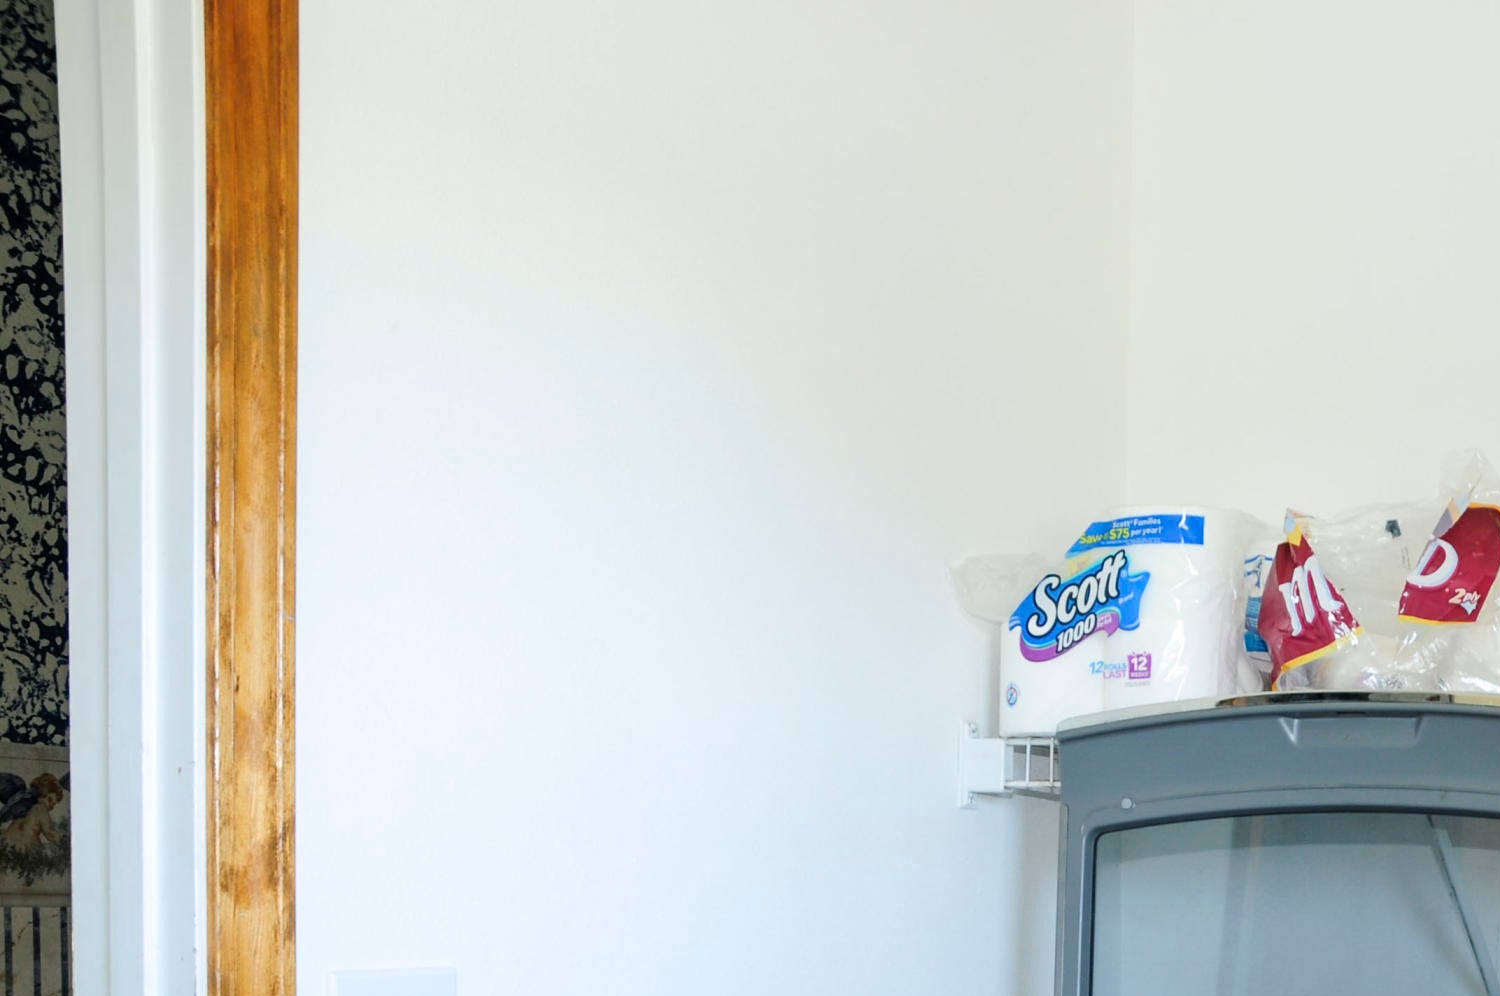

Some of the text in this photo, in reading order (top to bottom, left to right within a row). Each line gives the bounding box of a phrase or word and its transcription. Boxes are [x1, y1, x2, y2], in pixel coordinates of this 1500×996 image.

[1026, 549, 1127, 639] Scott
[1056, 612, 1098, 654] 1000
[1089, 661, 1104, 674] 12
[1131, 657, 1147, 671] 12
[1104, 670, 1127, 679] LAST
